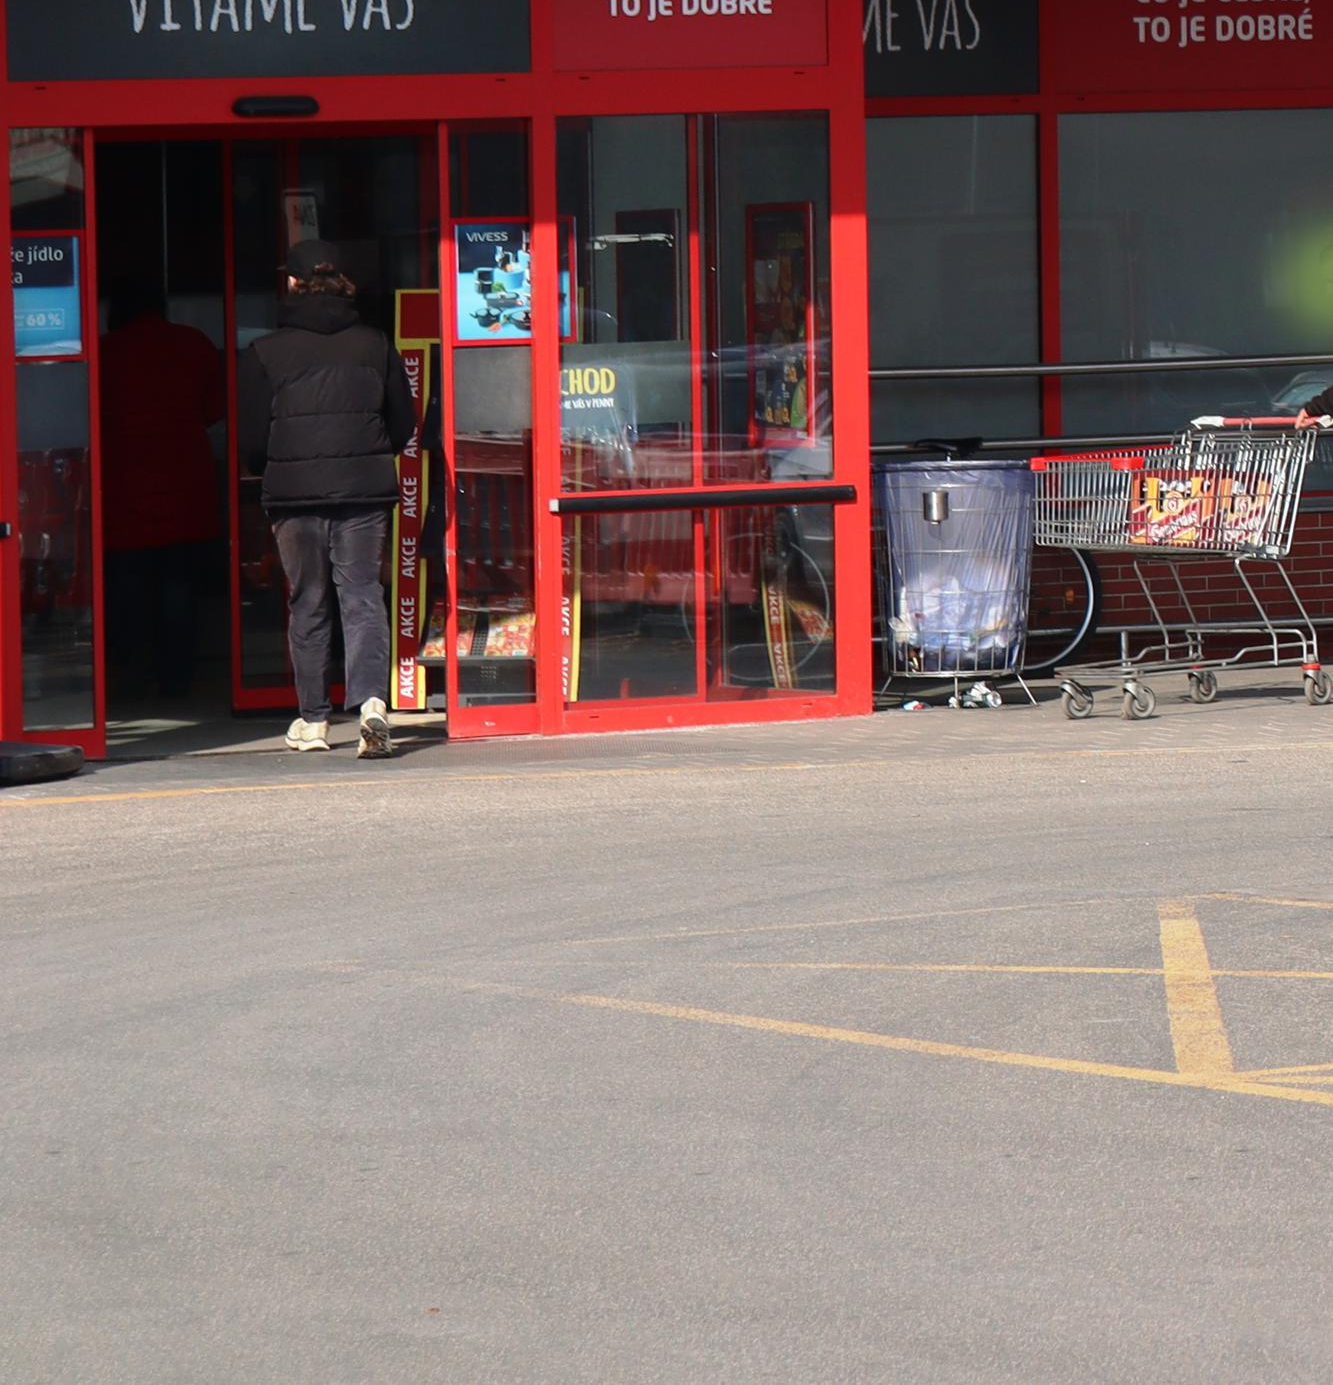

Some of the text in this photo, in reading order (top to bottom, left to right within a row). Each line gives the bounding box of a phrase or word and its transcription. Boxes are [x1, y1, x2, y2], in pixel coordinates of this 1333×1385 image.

[1134, 9, 1313, 47] TO JE DOBRÉ
[27, 245, 64, 265] jídlo
[466, 231, 509, 243] VIVESS
[403, 477, 417, 518] AKCE
[402, 537, 416, 578] AKCE
[401, 597, 415, 638] AKCE
[400, 656, 415, 698] AKCE
